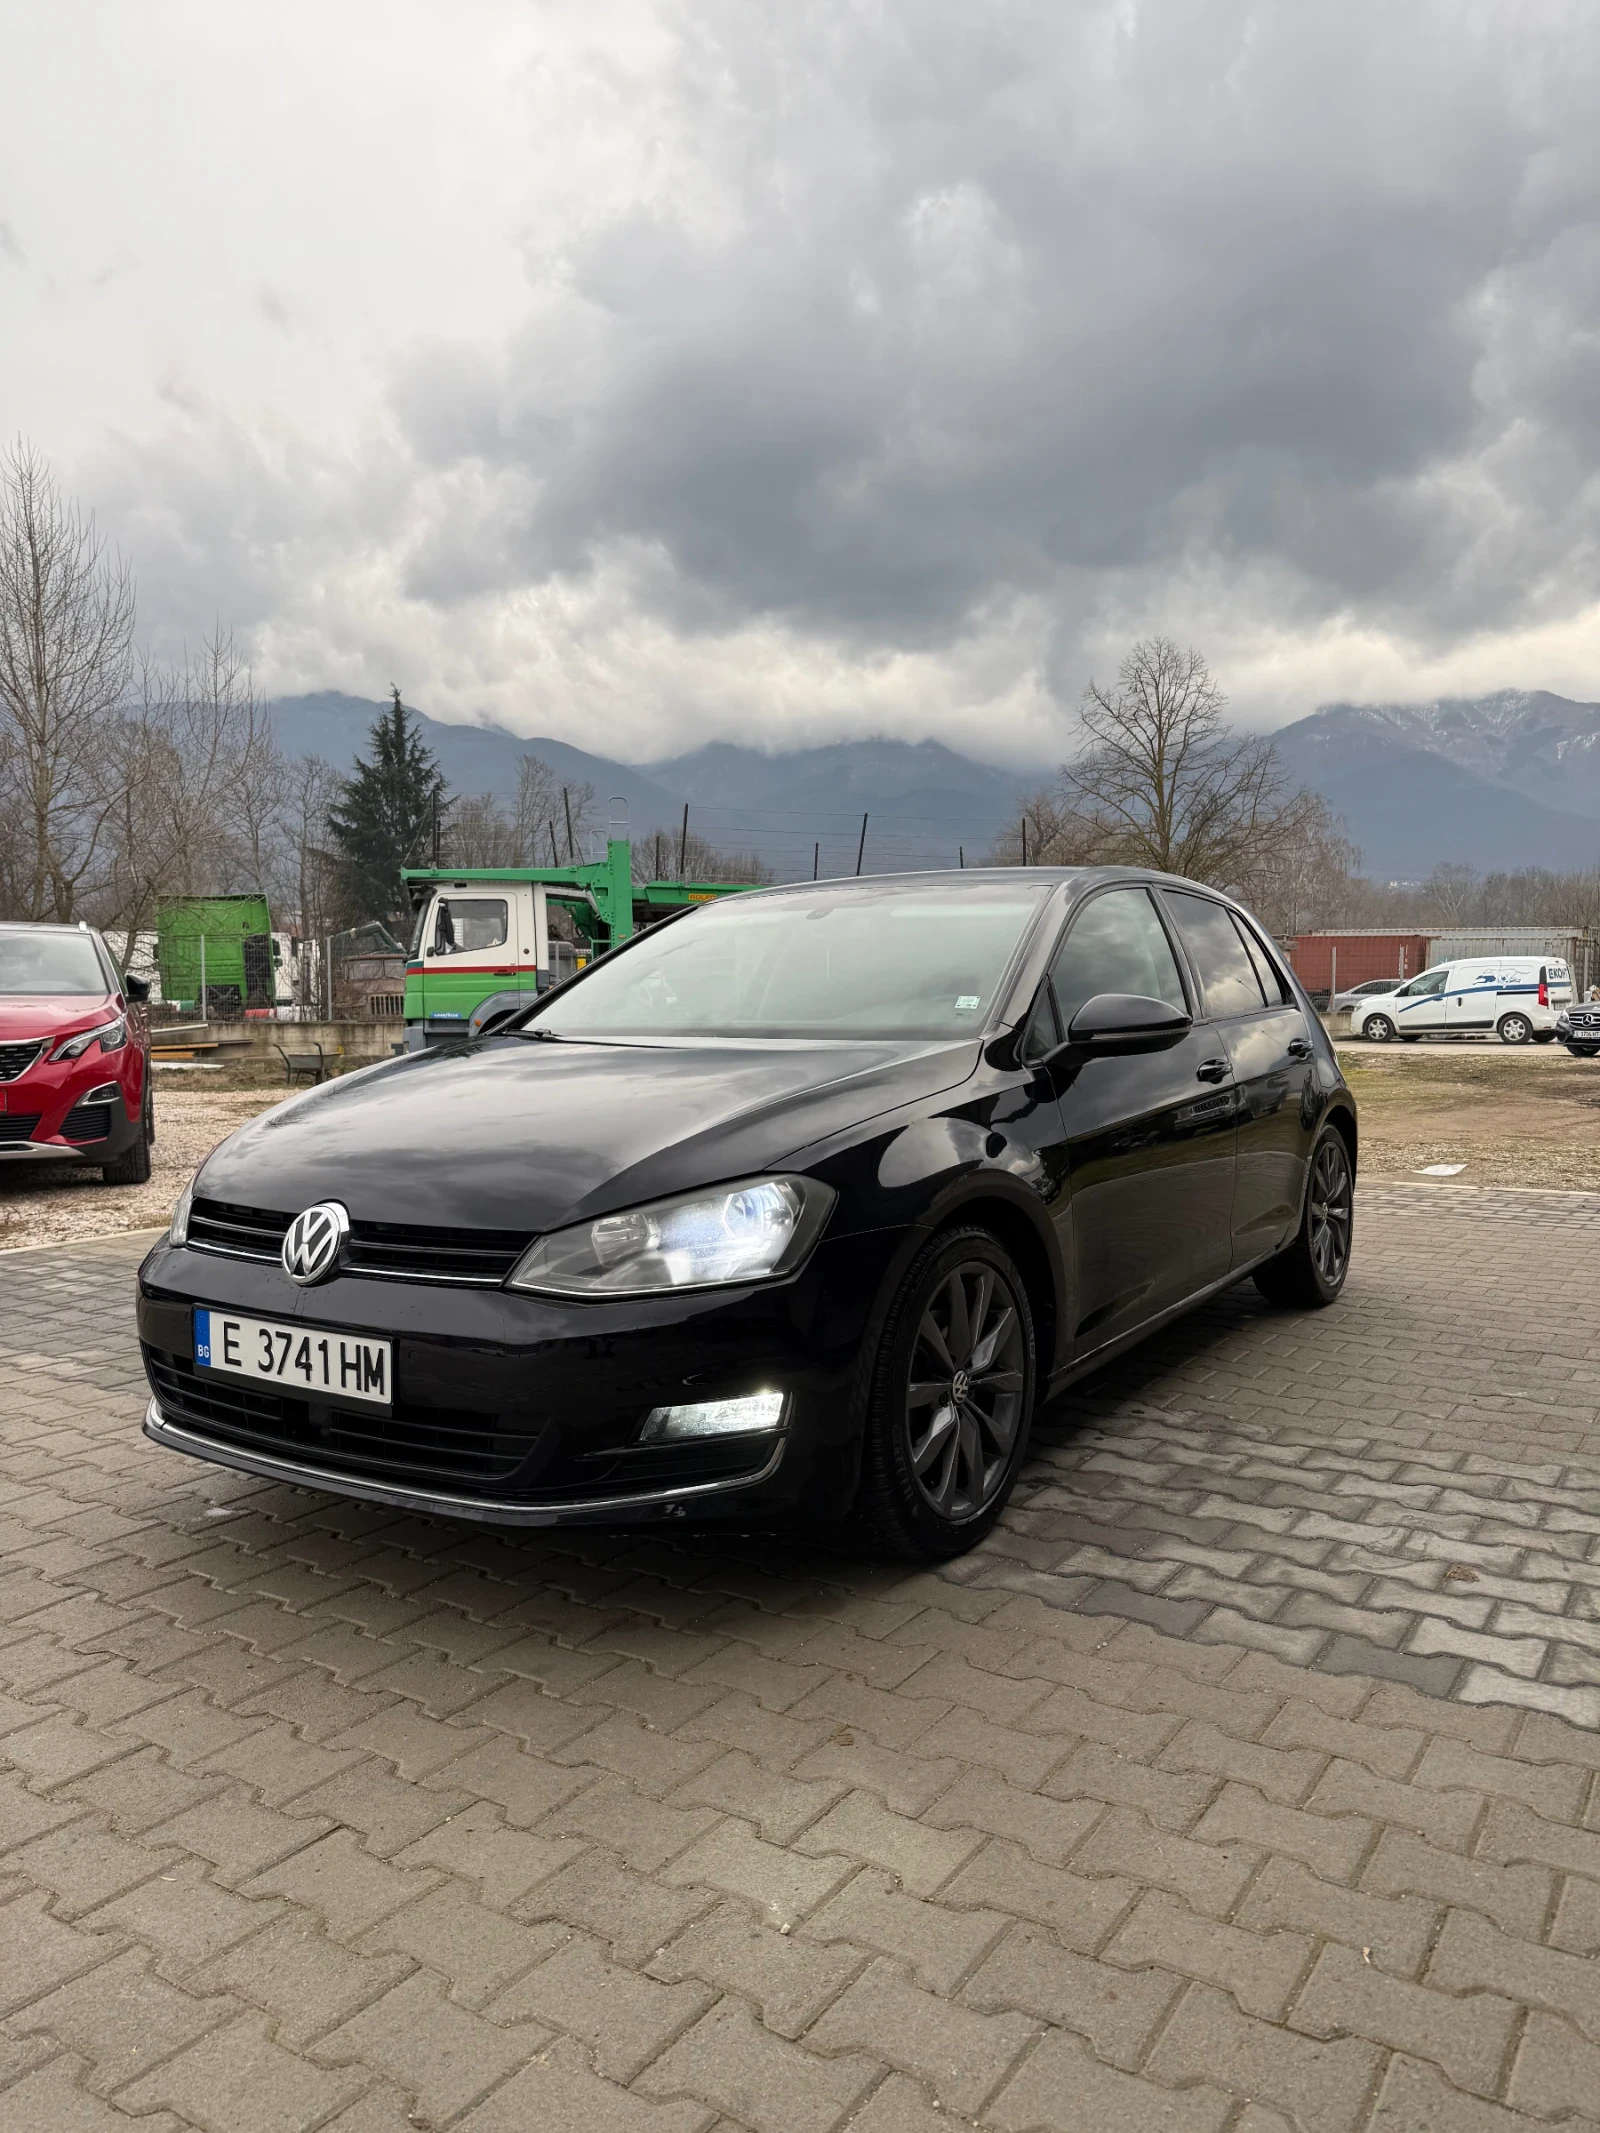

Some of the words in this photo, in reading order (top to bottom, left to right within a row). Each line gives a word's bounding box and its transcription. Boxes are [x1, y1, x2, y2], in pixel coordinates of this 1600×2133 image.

[197, 1344, 210, 1358] BG
[223, 1321, 242, 1367] E
[257, 1328, 330, 1385] 3741
[340, 1341, 385, 1396] HM
